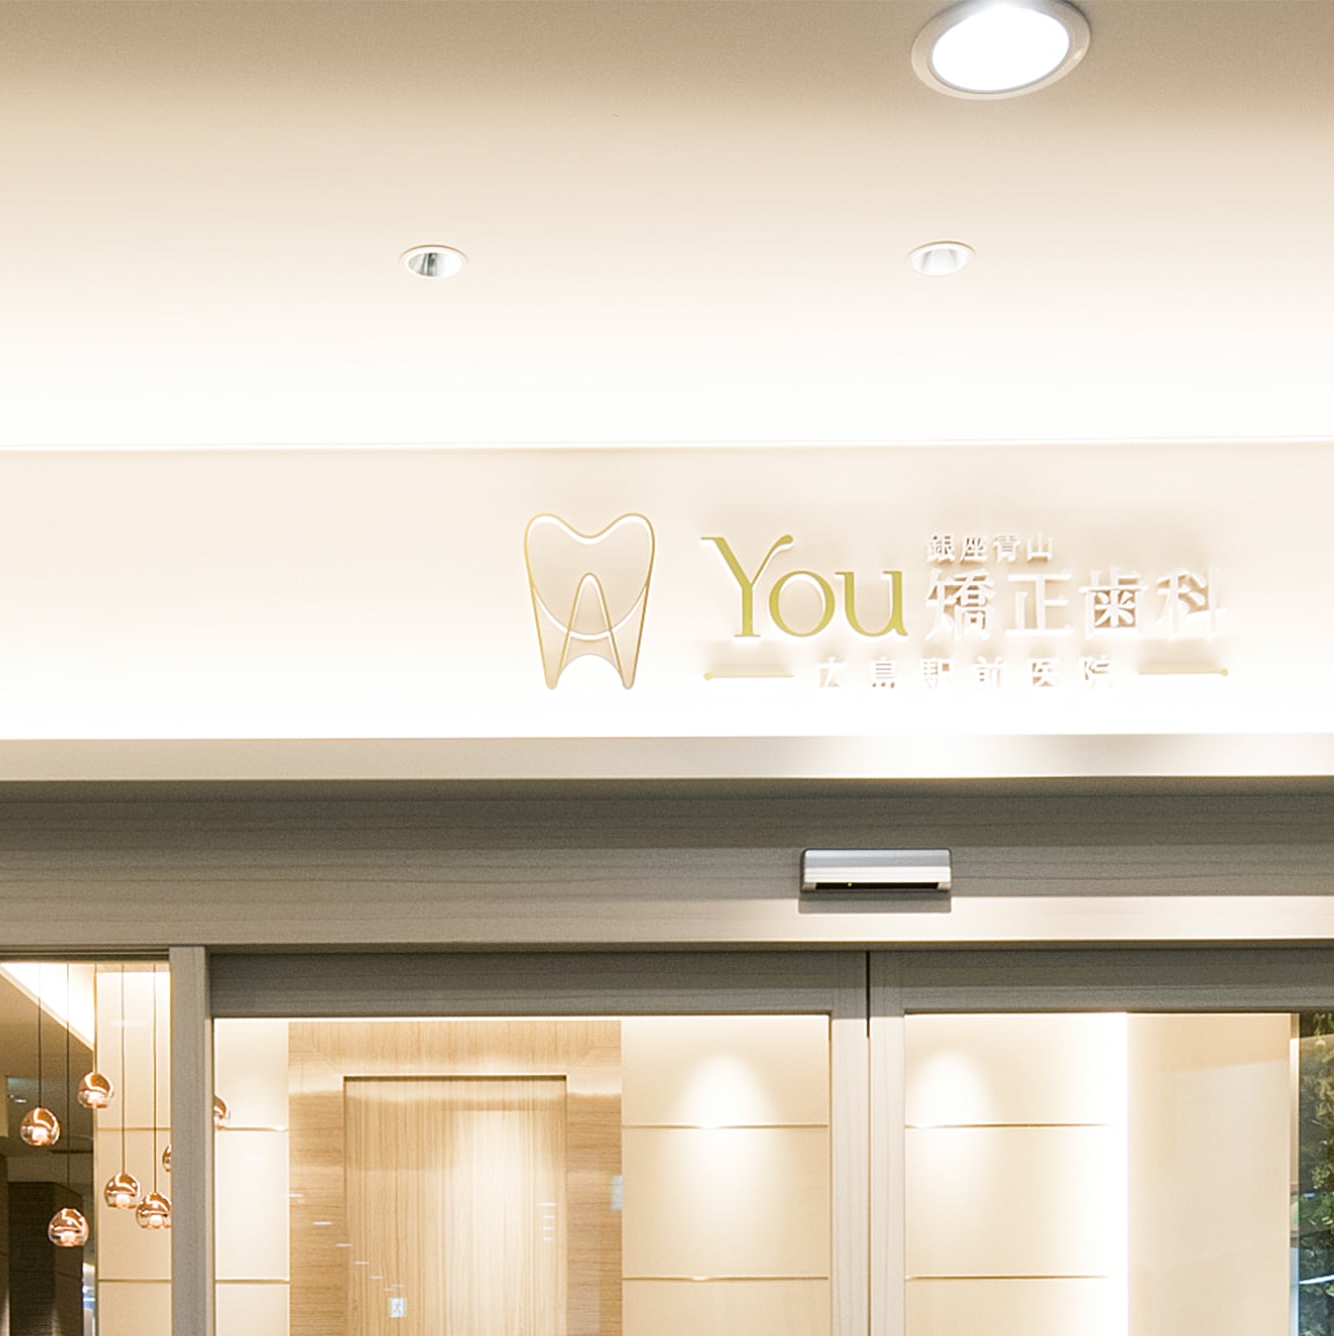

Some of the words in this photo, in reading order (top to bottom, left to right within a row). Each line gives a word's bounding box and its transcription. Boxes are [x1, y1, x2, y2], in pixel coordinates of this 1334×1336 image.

[701, 534, 909, 640] You
[925, 565, 1227, 641] 矯正歯科
